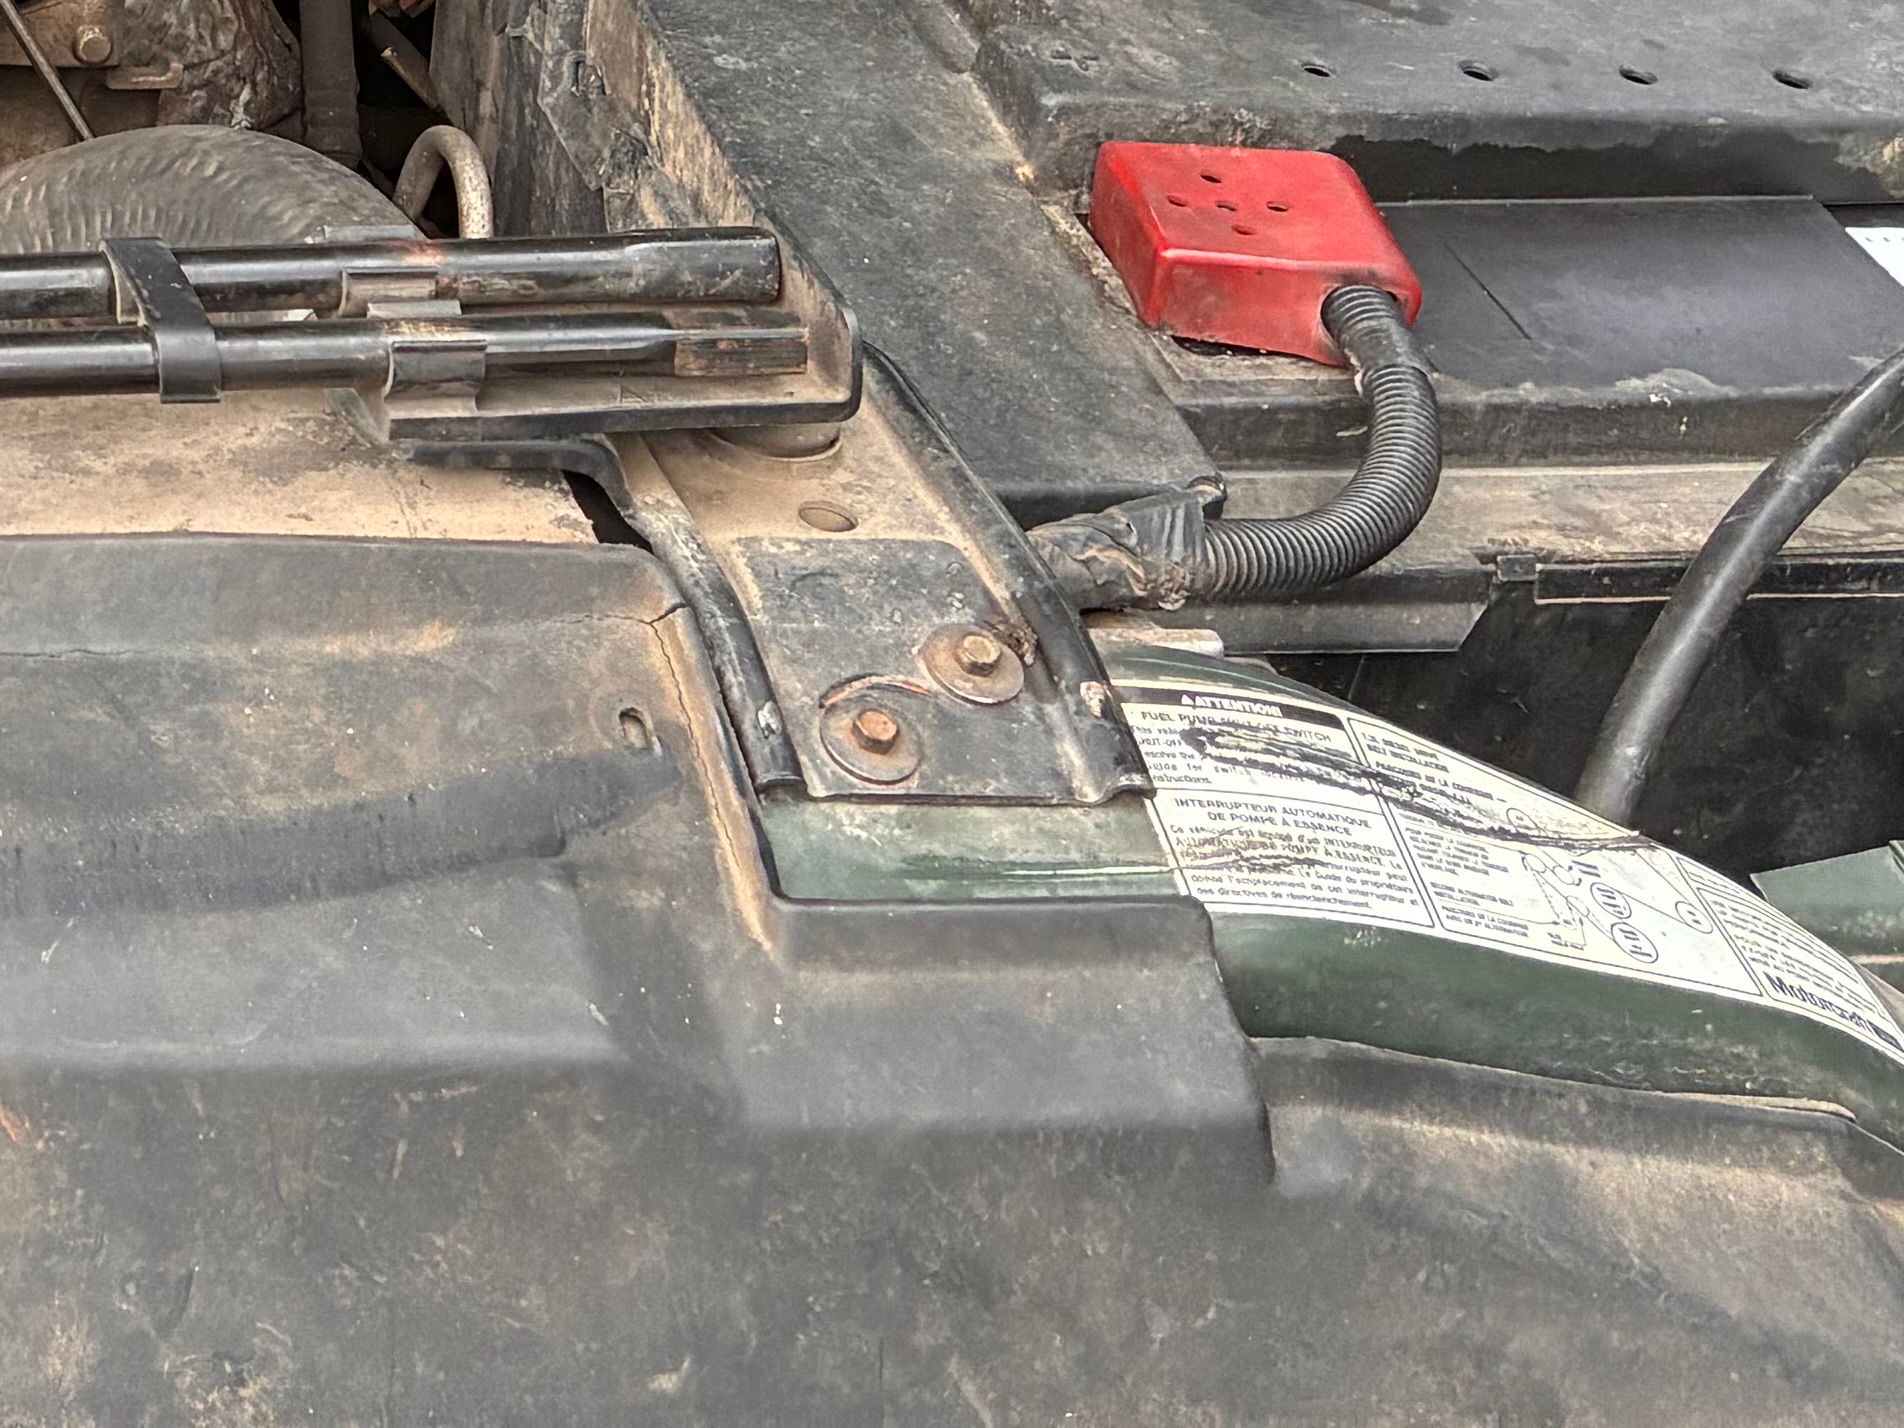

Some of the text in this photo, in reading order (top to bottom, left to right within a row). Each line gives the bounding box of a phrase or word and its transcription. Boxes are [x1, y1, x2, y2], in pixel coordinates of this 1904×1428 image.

[1141, 711, 1175, 723] FUEL
[1175, 797, 1373, 829] INTERRUPTEUR AUTOMATIQUE
[1207, 811, 1226, 821] DE
[1229, 812, 1277, 826] POMPE
[1293, 819, 1353, 836] ESSENCE
